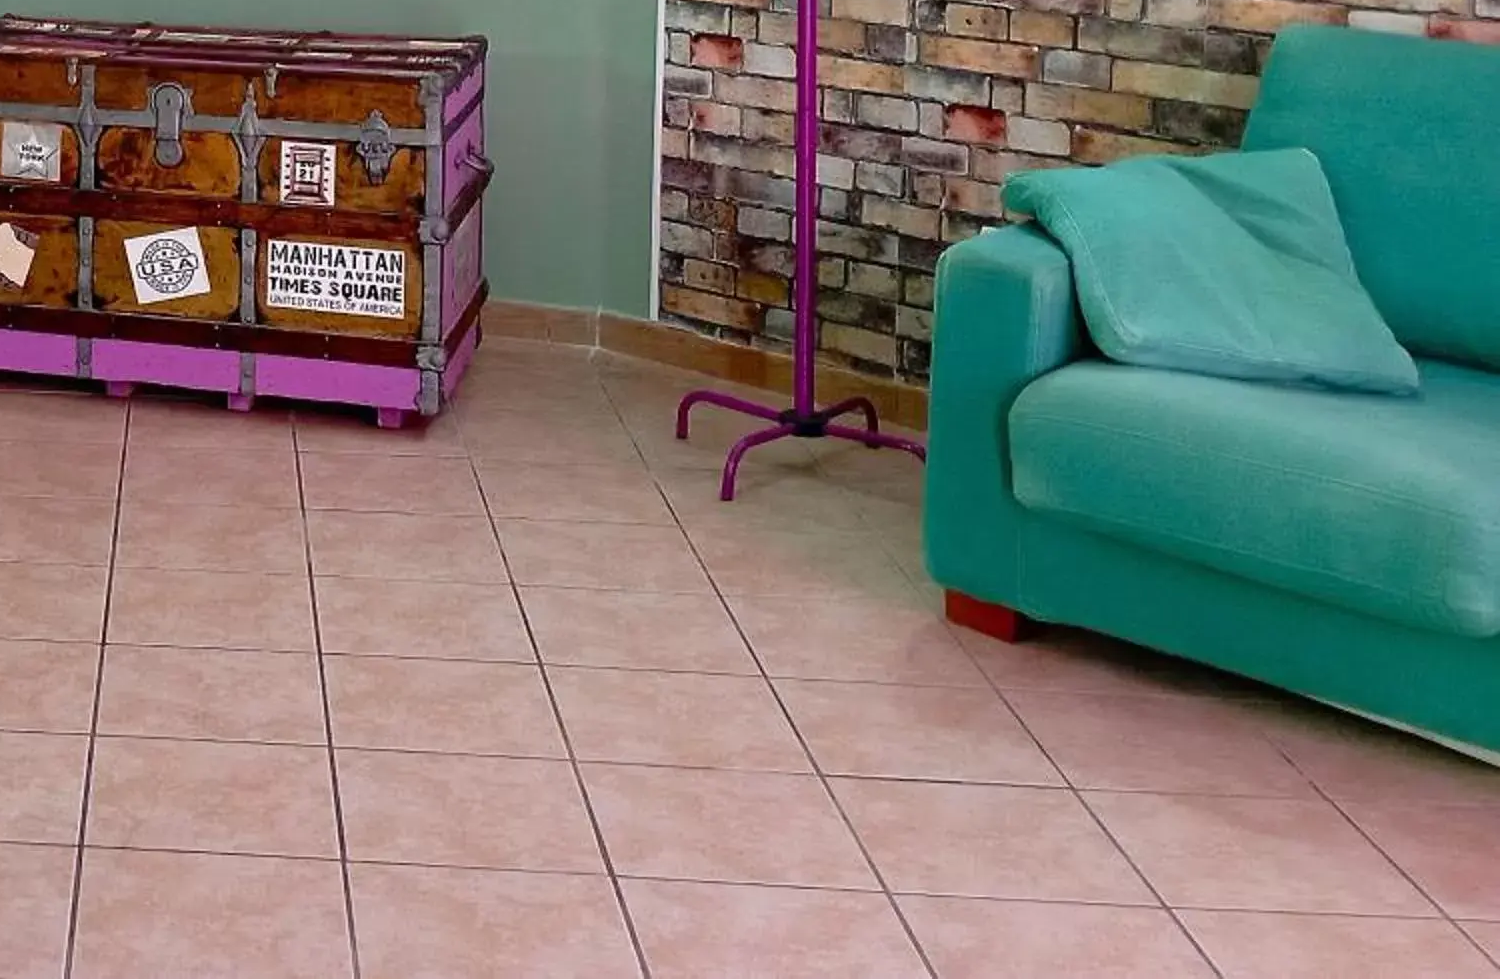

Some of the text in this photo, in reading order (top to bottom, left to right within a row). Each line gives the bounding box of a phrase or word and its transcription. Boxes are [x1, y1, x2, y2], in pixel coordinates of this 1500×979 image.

[19, 152, 45, 162] YORK
[21, 144, 43, 153] NEW
[299, 168, 314, 180] 21
[141, 257, 195, 277] USA
[270, 242, 403, 273] MANHATTAN
[270, 264, 402, 284] MADISON AVENUE
[269, 276, 403, 303] TIMES SQUARE
[270, 292, 403, 316] UNITED STATES OF AMERICA
